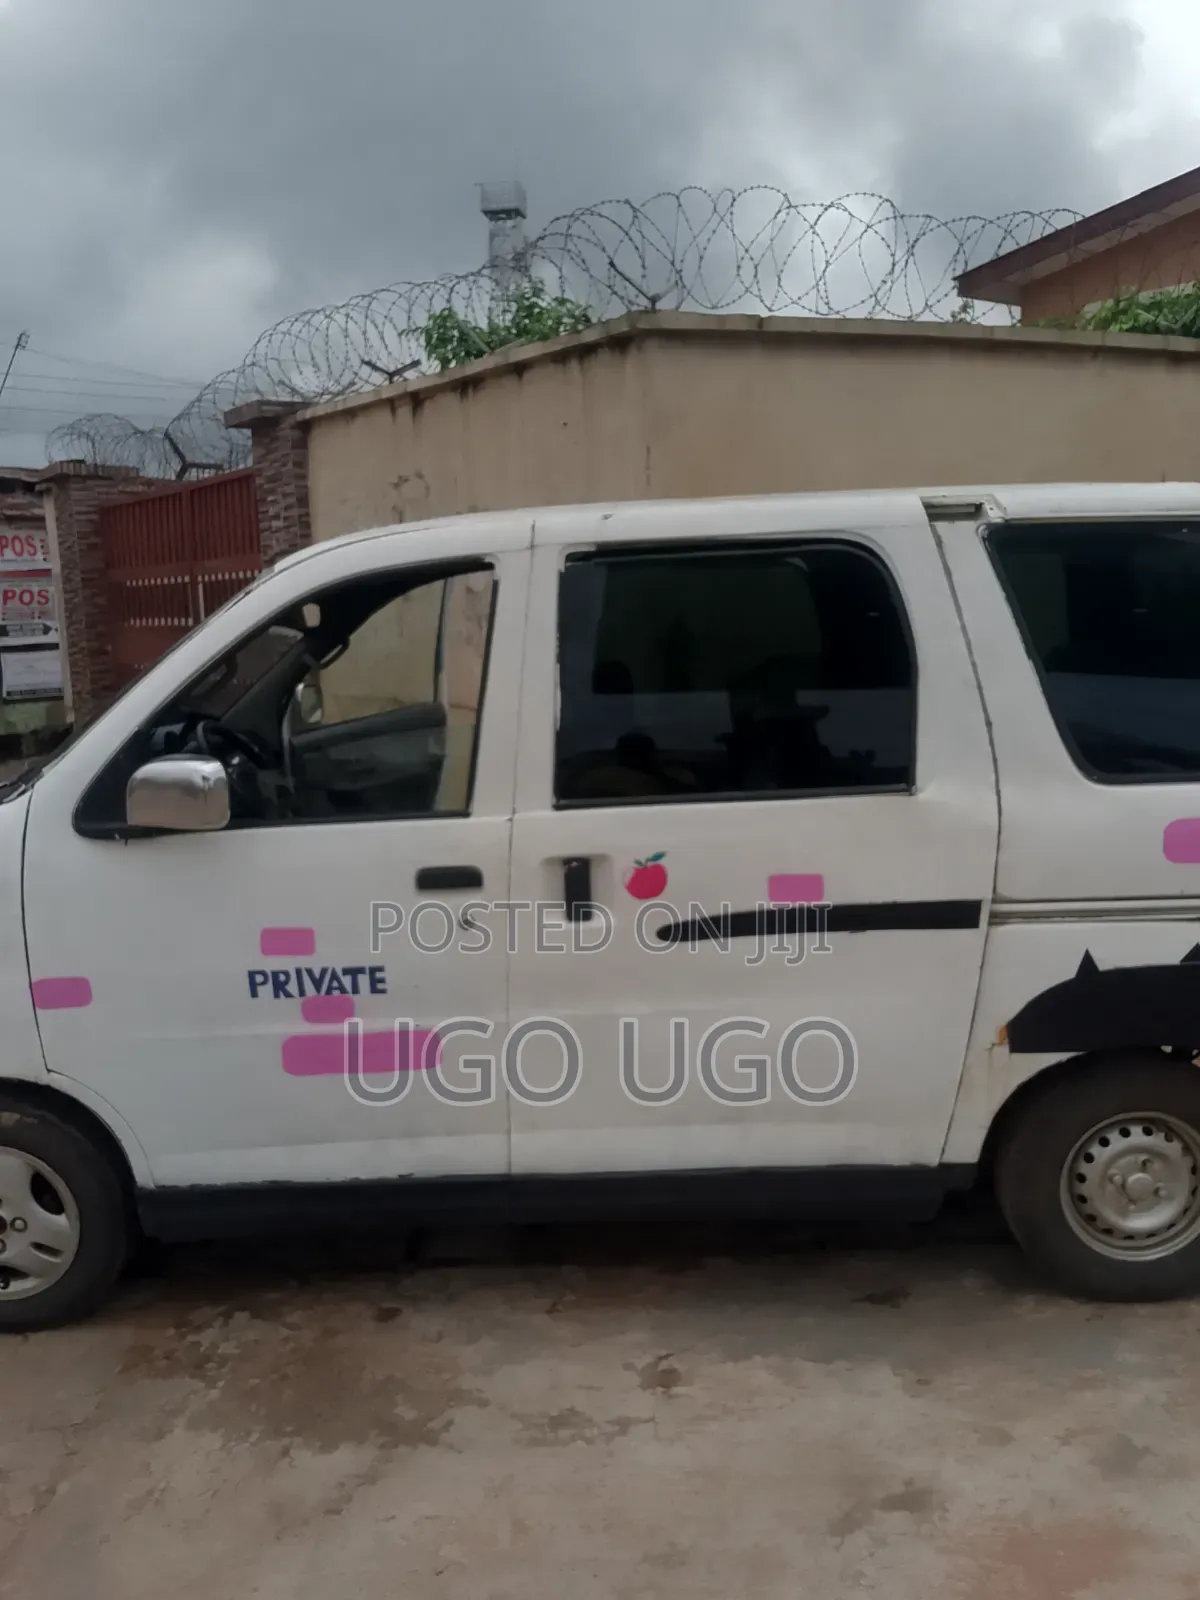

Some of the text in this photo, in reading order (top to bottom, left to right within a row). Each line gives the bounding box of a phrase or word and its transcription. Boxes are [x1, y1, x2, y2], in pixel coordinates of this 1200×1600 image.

[0, 534, 37, 557] POS
[2, 588, 50, 607] POS
[247, 965, 388, 999] PRIVATE
